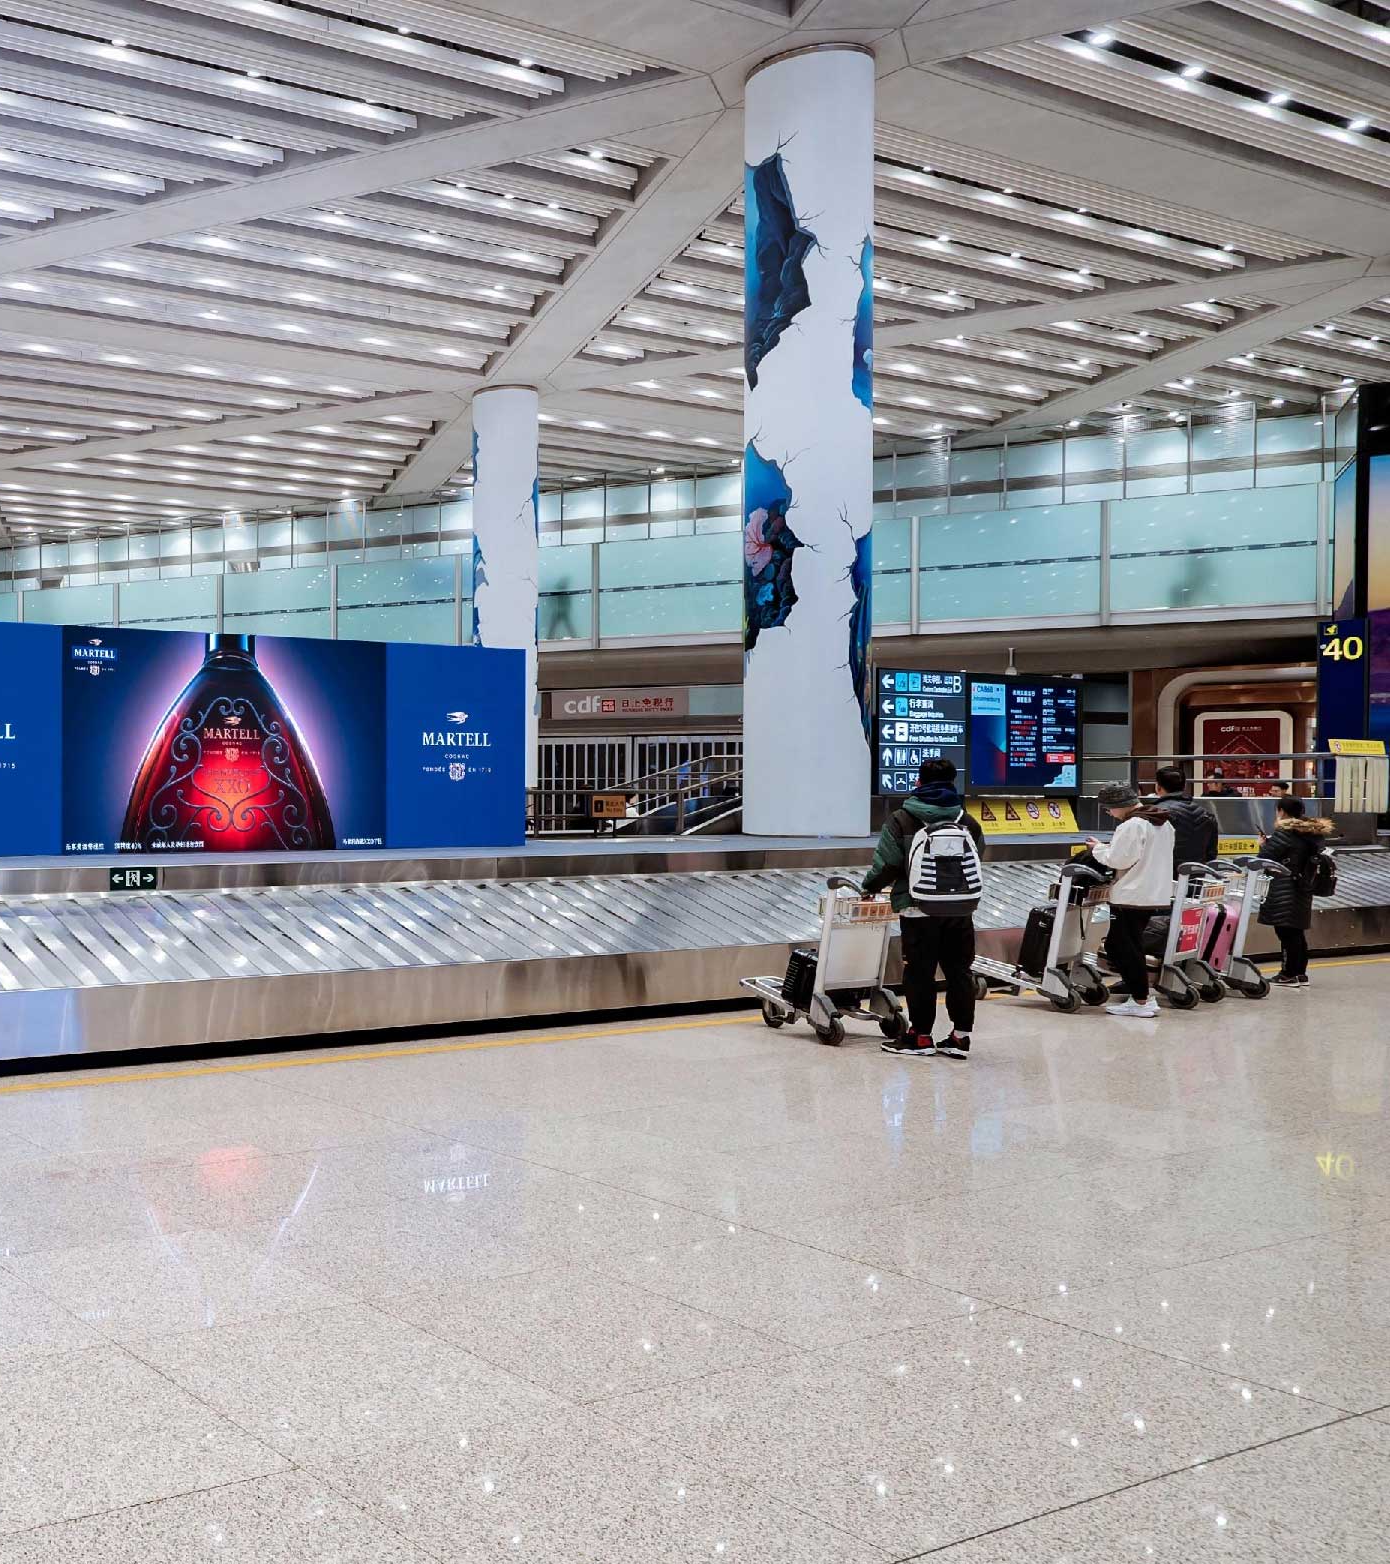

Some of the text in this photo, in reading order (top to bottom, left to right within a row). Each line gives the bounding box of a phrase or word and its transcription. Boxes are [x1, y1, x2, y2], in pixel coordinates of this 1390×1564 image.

[74, 648, 116, 659] MARTELL
[1322, 636, 1363, 661] 40
[953, 675, 963, 694] B
[564, 695, 601, 714] cdf
[203, 728, 261, 740] MARTELL
[422, 731, 492, 747] MARTELL
[214, 778, 251, 794] XXO
